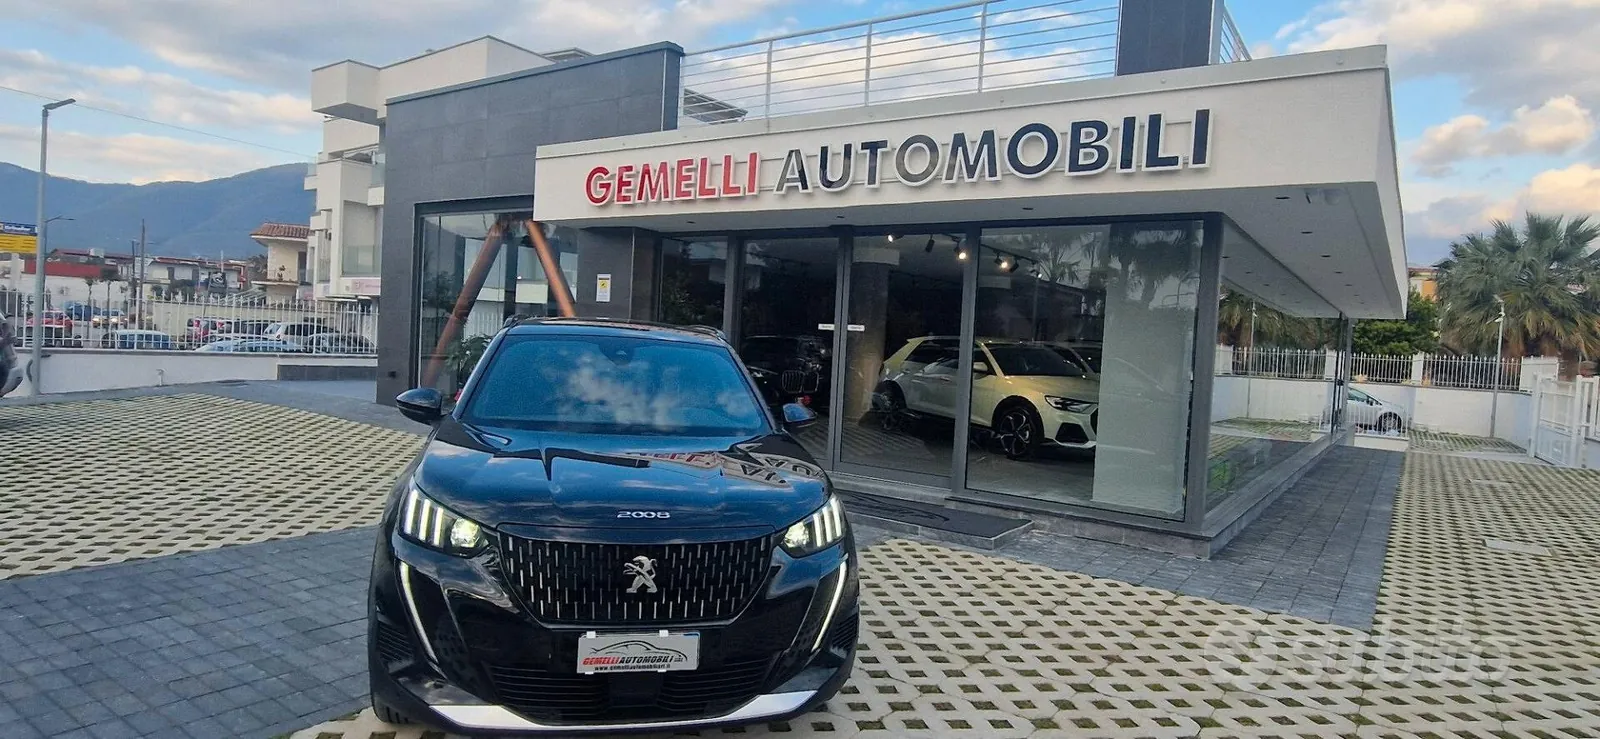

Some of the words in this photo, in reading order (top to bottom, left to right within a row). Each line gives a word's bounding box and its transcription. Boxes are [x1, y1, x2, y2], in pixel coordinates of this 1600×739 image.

[584, 150, 759, 206] GEMELLI
[776, 108, 1212, 193] AUTOMOBILI
[617, 511, 671, 519] 2008
